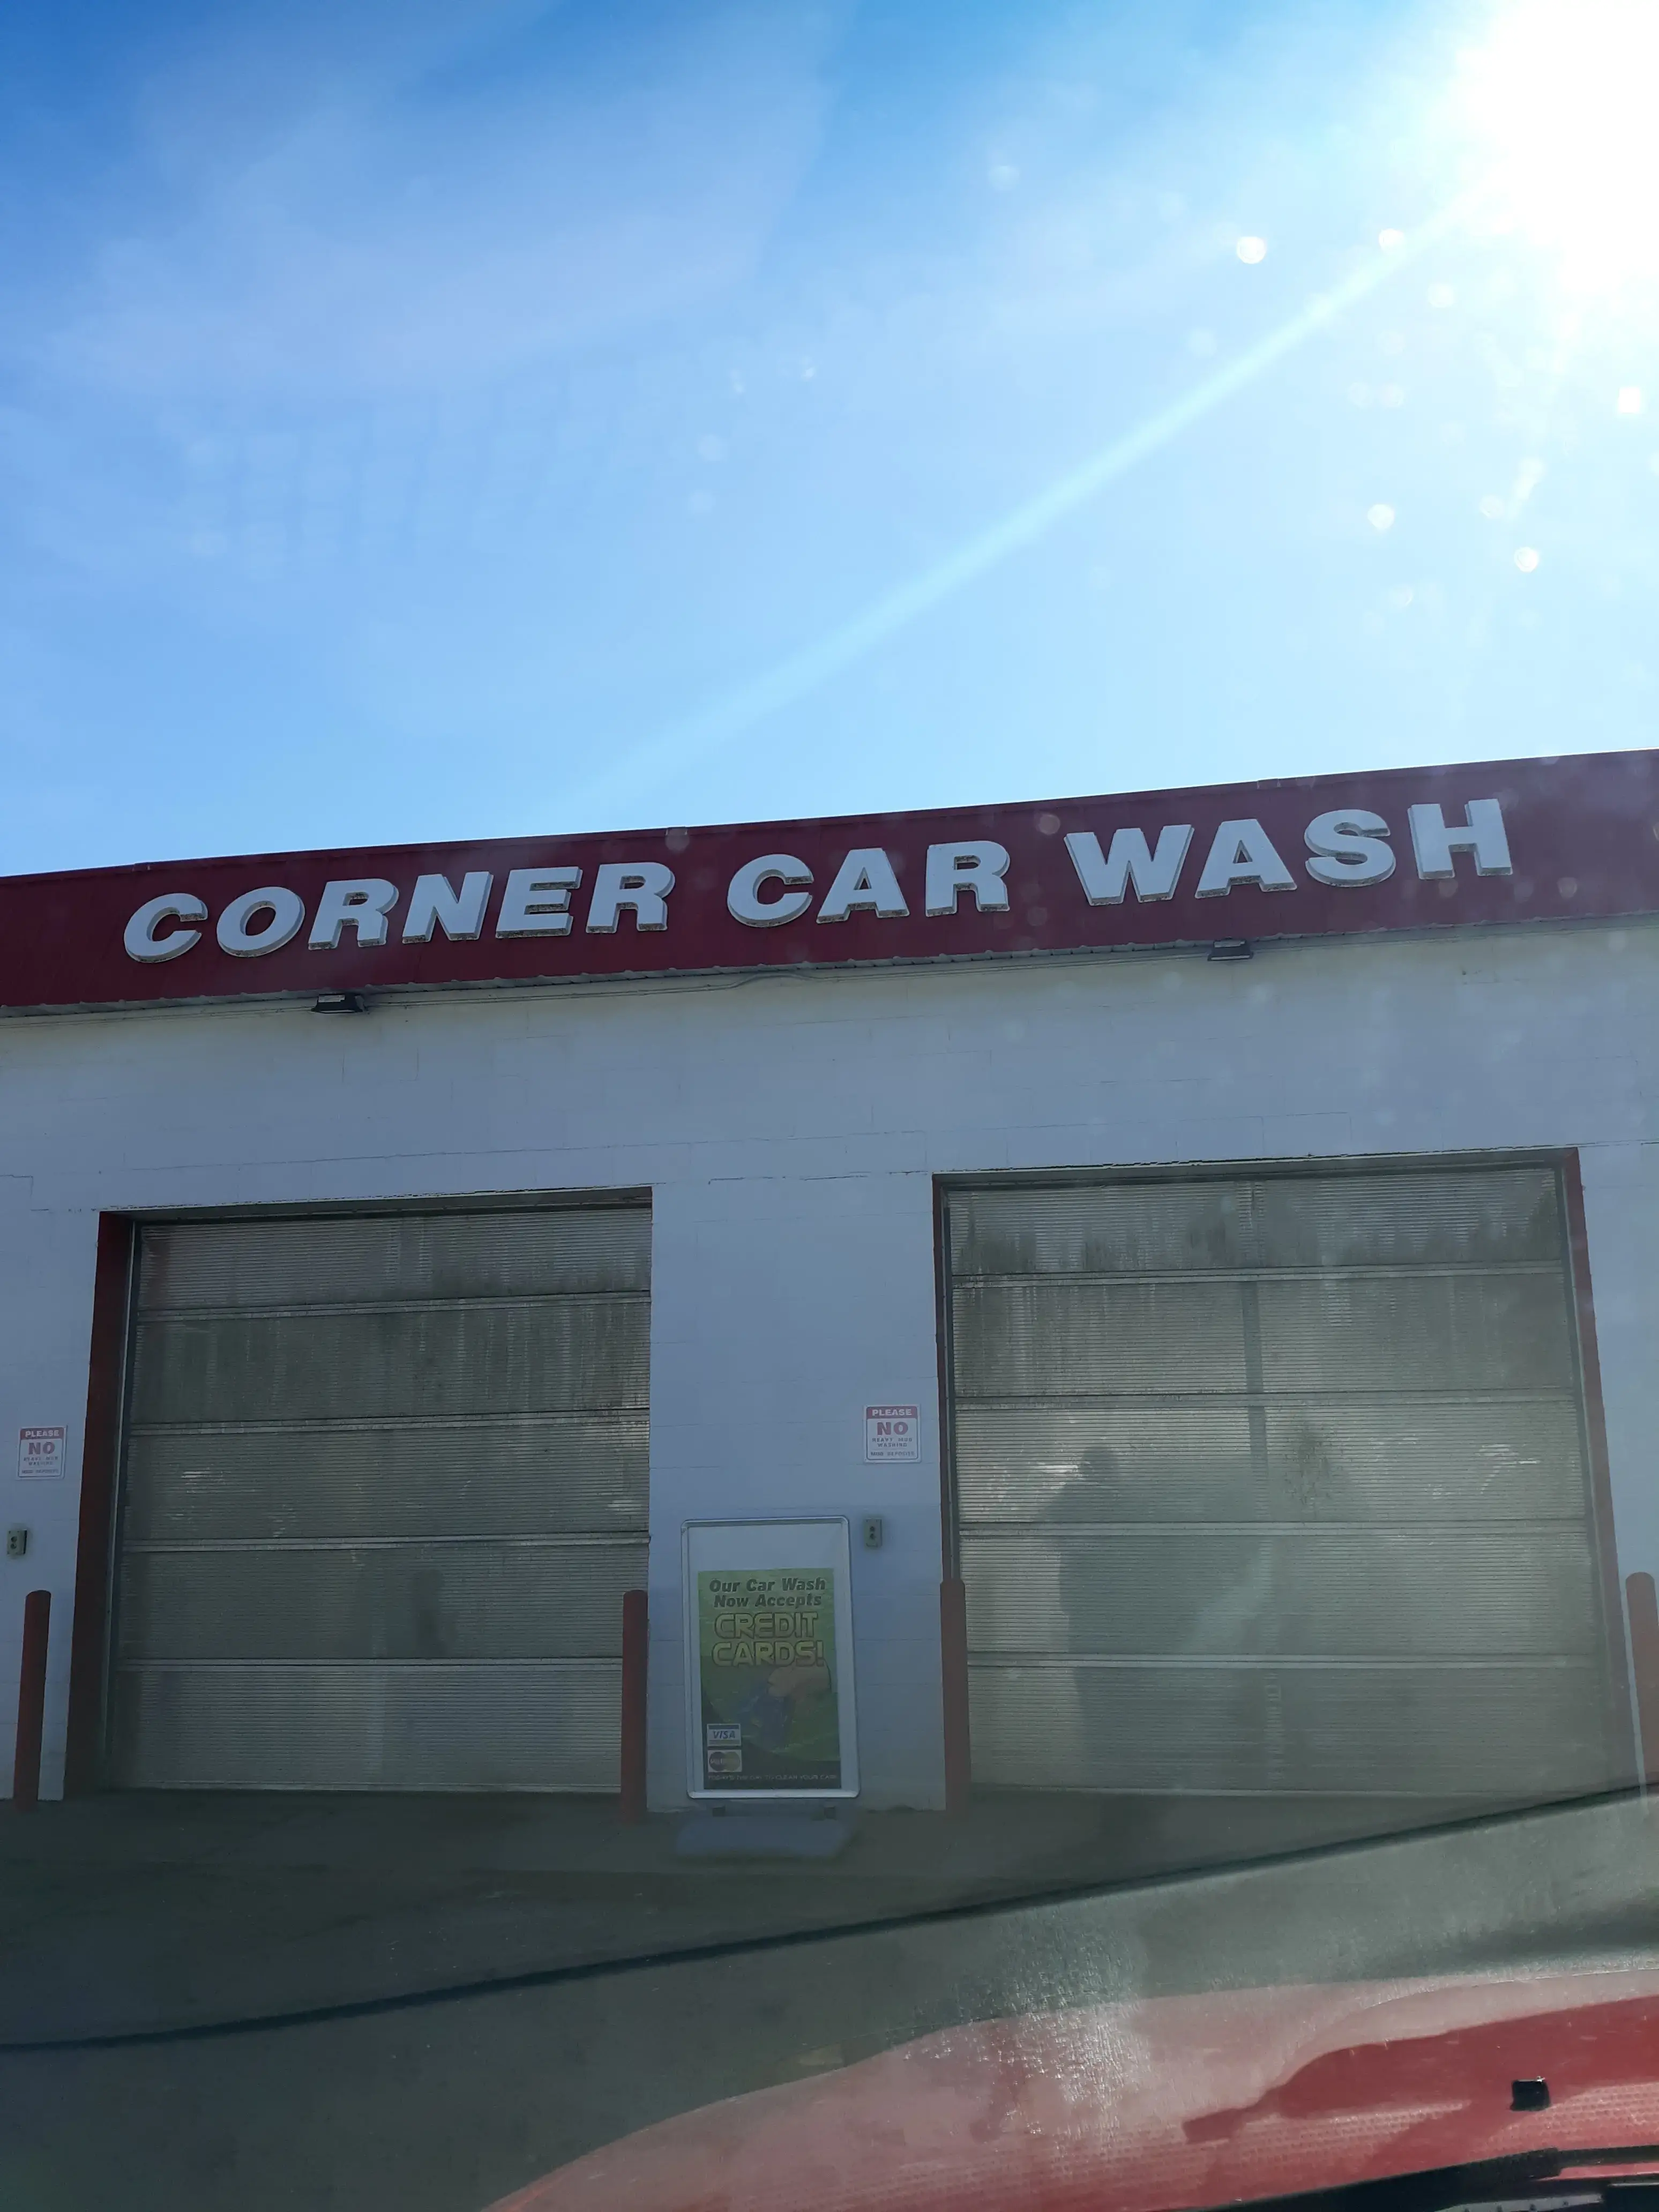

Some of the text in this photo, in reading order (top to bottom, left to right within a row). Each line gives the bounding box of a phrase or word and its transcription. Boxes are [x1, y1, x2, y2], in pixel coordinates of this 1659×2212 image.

[124, 798, 1514, 963] CORNER CAR WASH
[25, 1430, 59, 1438] PLEASE
[877, 1421, 909, 1436] NO
[28, 1441, 56, 1455] NO
[709, 1577, 826, 1593] Our Car Wash
[713, 1593, 822, 1609] Now Accepts
[714, 1611, 819, 1640] CREDIT
[711, 1640, 825, 1668] CARDS!
[713, 1730, 736, 1739] VISA
